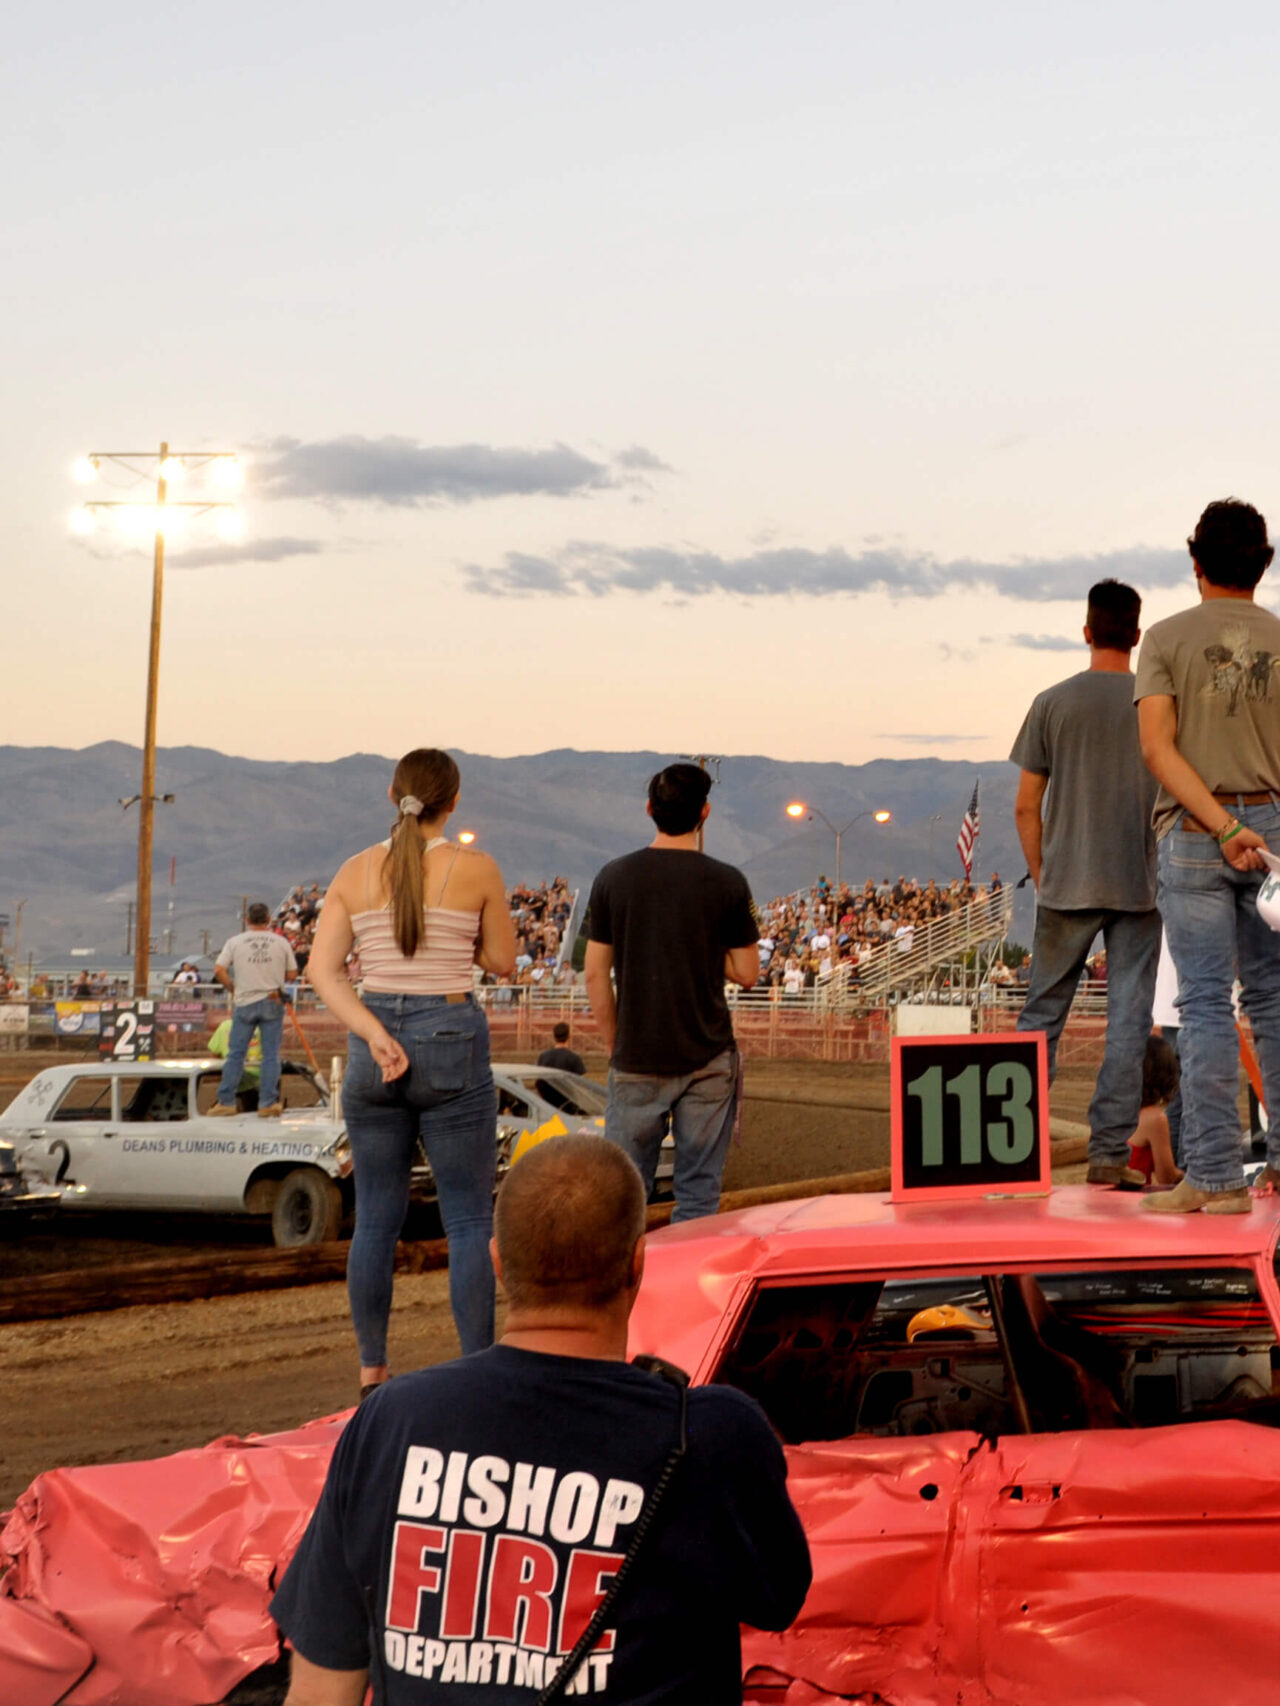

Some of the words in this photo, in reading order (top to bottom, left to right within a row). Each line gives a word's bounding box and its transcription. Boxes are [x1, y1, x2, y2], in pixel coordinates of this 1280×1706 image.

[113, 1012, 138, 1055] 2
[122, 1139, 166, 1153] DEANS
[169, 1139, 235, 1154] PLUMBING
[239, 1141, 248, 1154] &
[251, 1142, 314, 1157] HEATING
[907, 1061, 1034, 1166] 113
[48, 1139, 76, 1186] 2
[397, 1445, 645, 1548] BISHOP
[385, 1520, 627, 1656] FIRE
